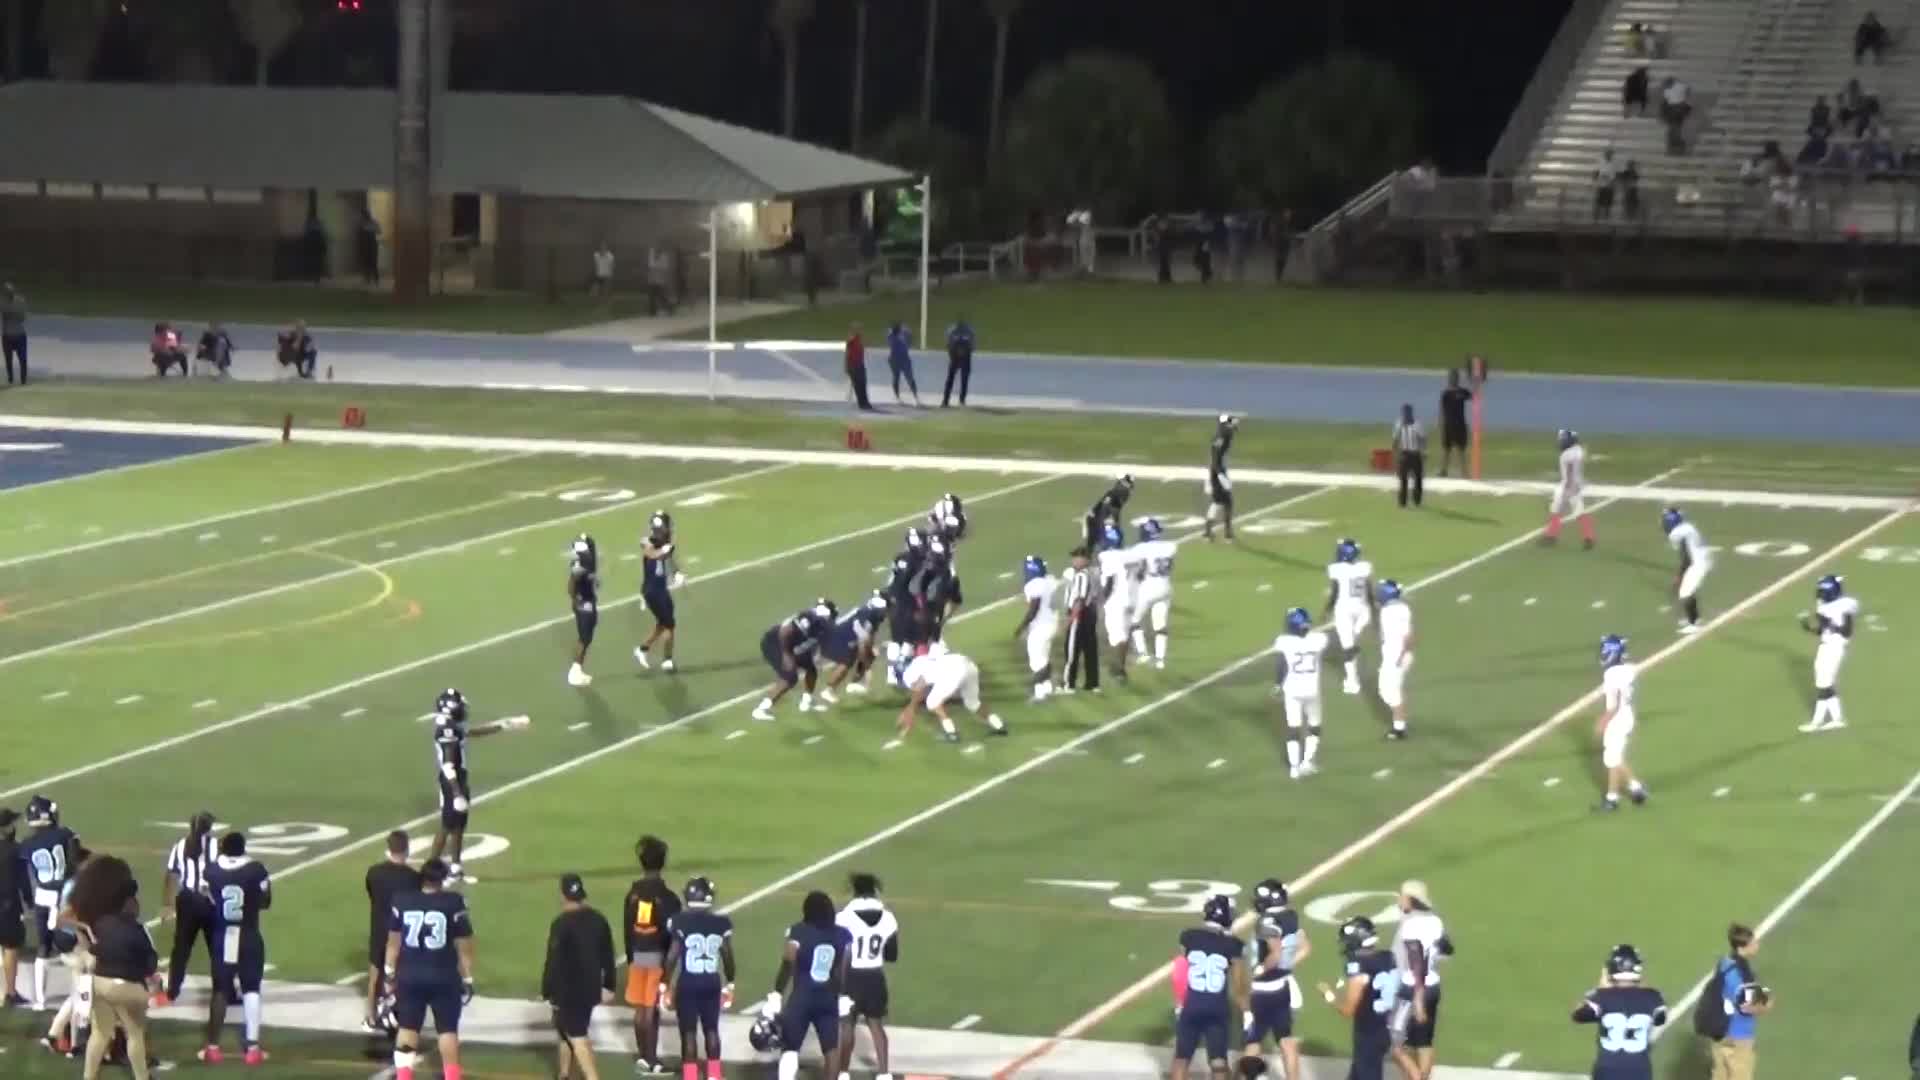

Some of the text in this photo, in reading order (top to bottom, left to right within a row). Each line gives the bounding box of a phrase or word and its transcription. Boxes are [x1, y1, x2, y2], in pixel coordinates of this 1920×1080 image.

[221, 884, 244, 921] 2
[403, 910, 447, 950] 73
[857, 934, 883, 961] 19
[1187, 950, 1228, 993] 26
[1600, 1012, 1653, 1053] 33
